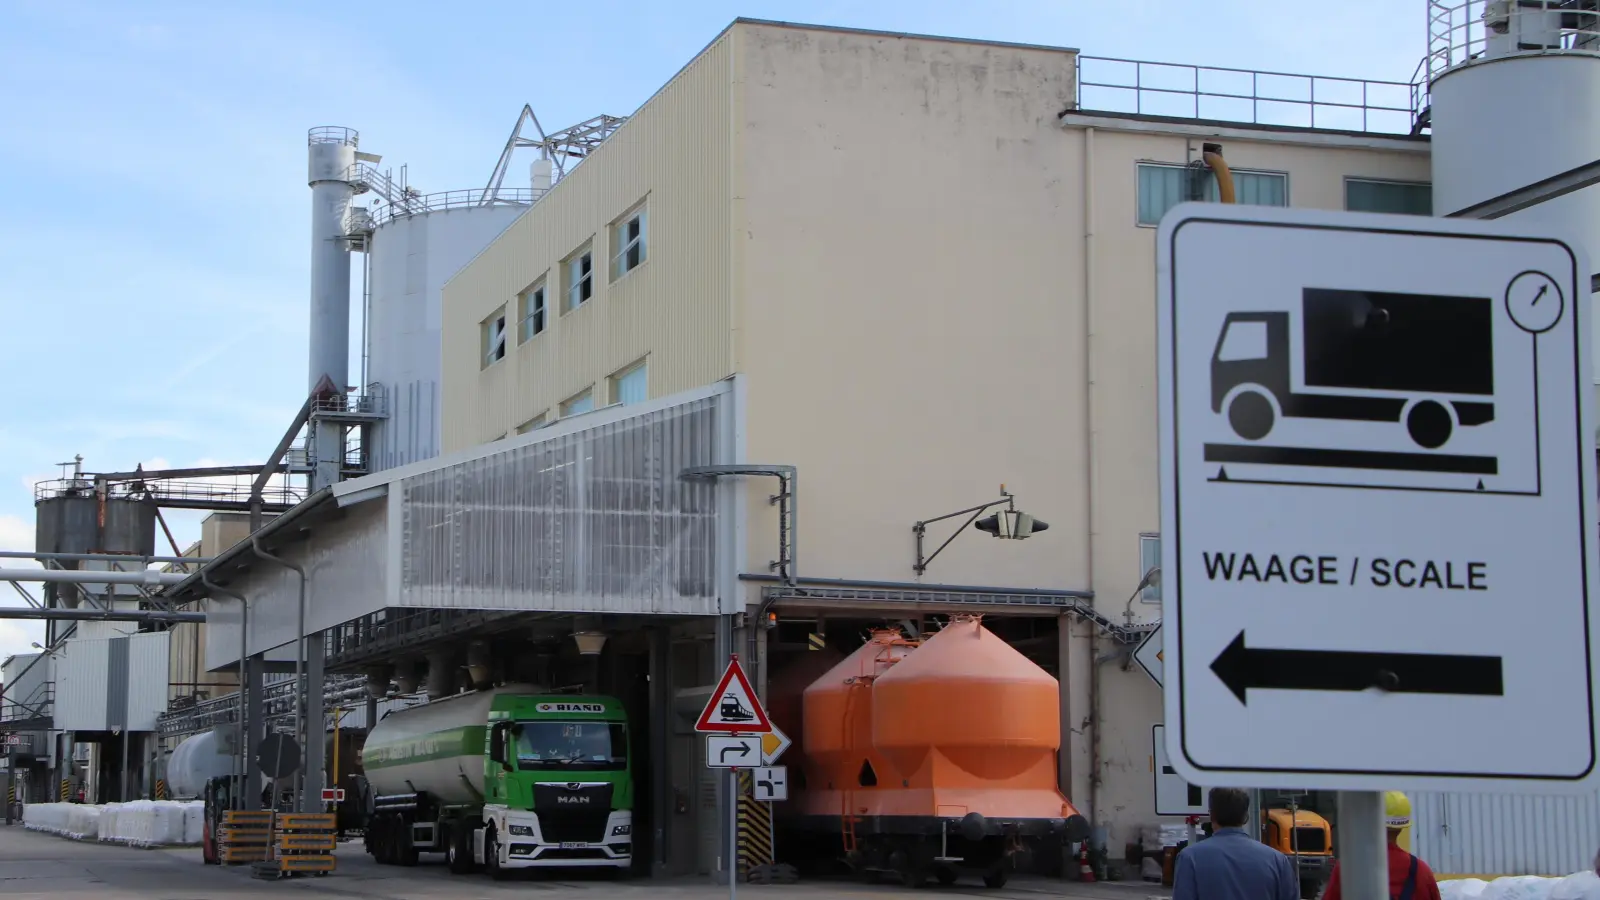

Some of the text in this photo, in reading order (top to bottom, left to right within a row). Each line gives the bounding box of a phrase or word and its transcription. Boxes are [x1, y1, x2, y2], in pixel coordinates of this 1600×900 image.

[1202, 551, 1488, 591] WAAGE / SCALE
